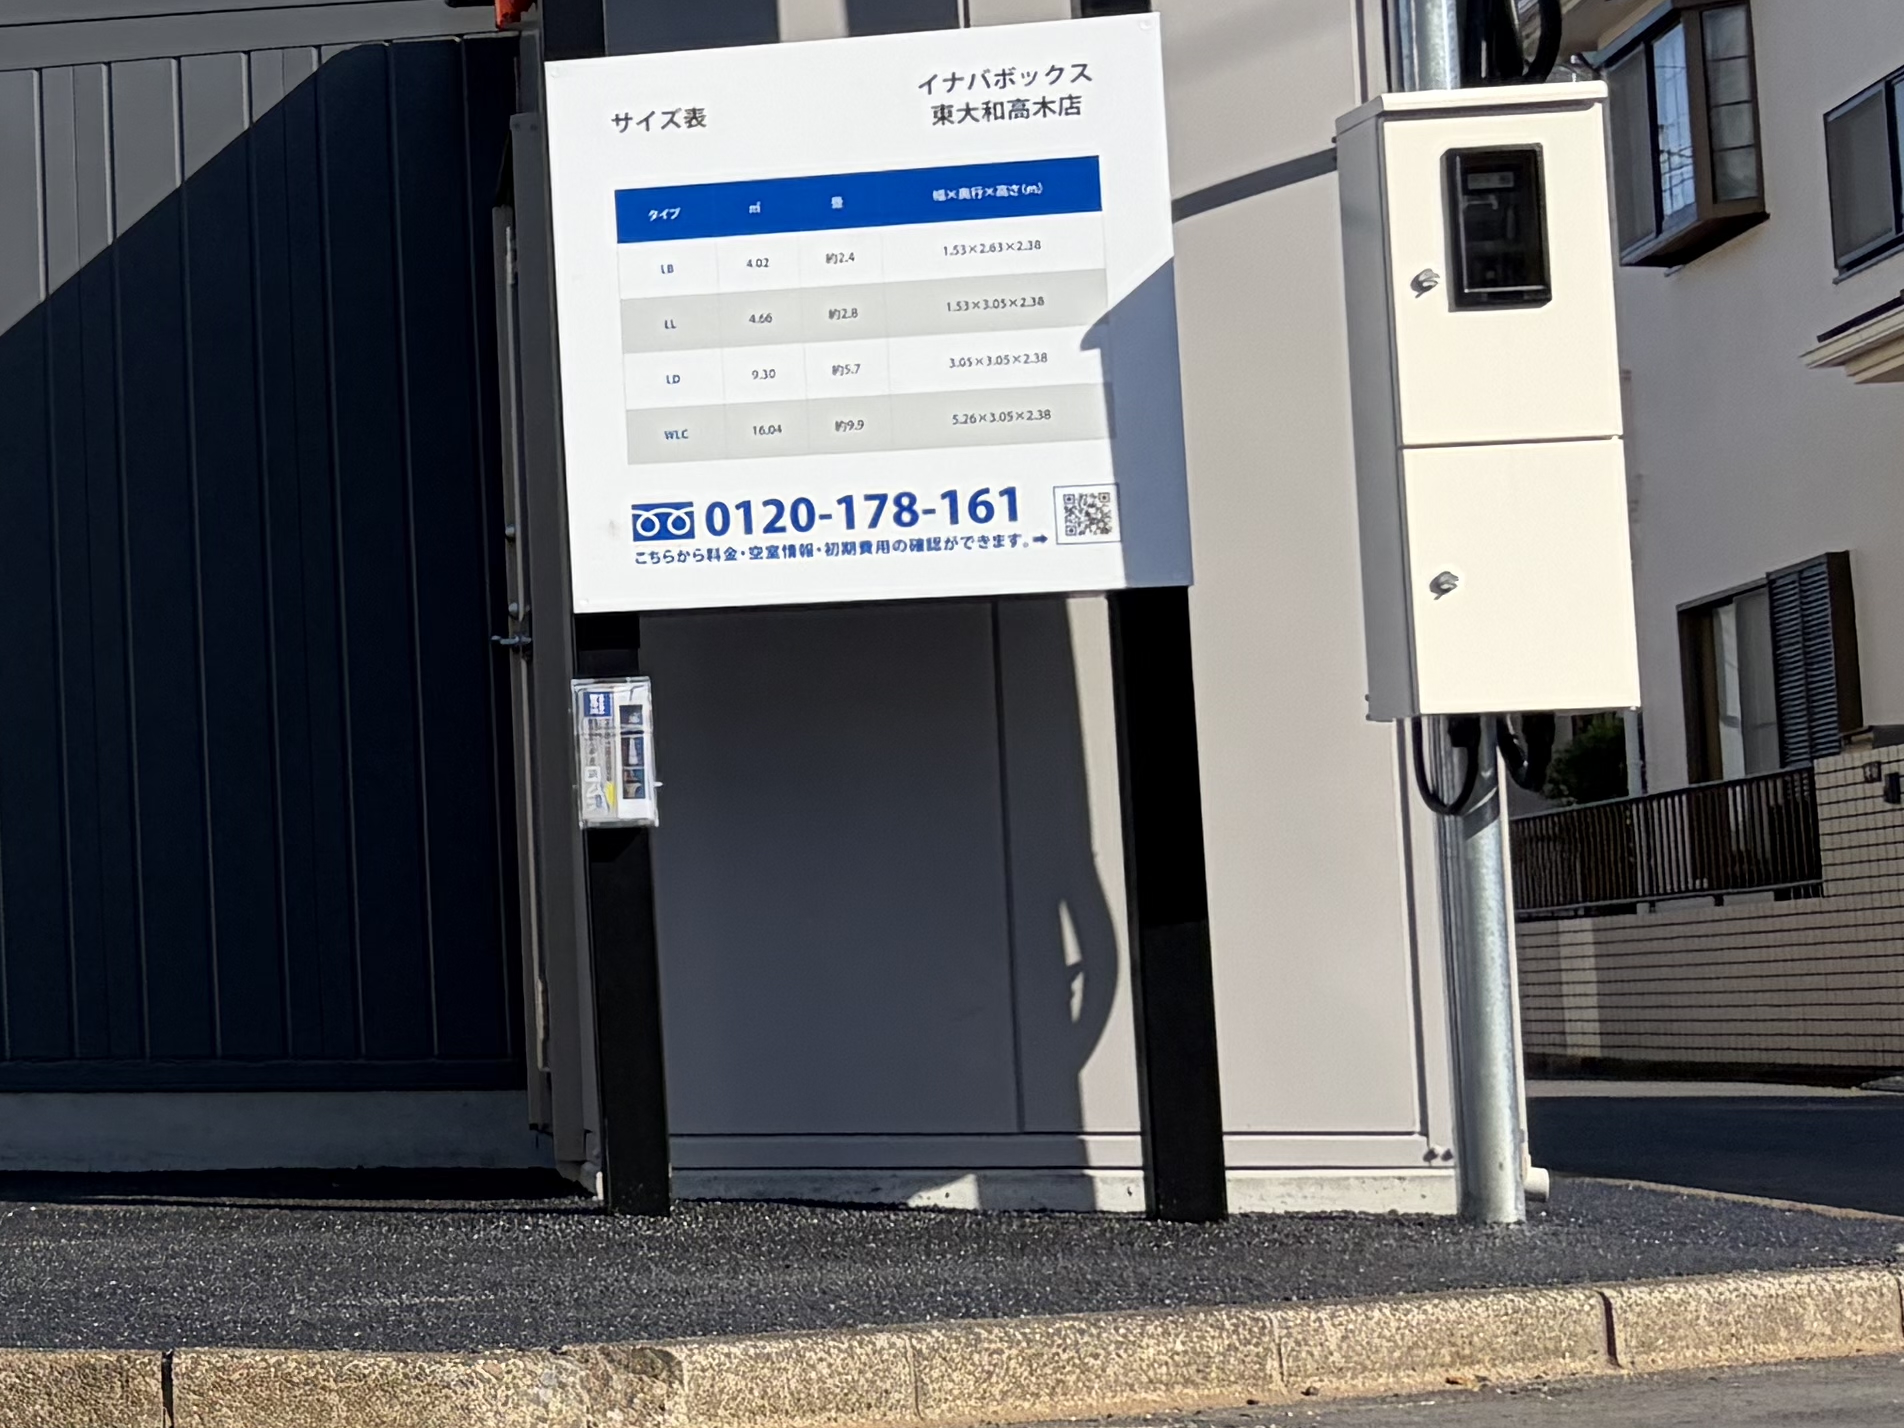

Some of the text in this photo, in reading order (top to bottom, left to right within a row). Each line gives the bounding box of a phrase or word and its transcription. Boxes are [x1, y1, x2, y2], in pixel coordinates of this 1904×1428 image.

[918, 62, 1093, 96] イナバボックス
[611, 107, 707, 133] サイズ表
[931, 94, 1082, 126] 東大和高木店
[751, 368, 776, 380] 9.30
[705, 486, 1018, 536] 0120-178-161
